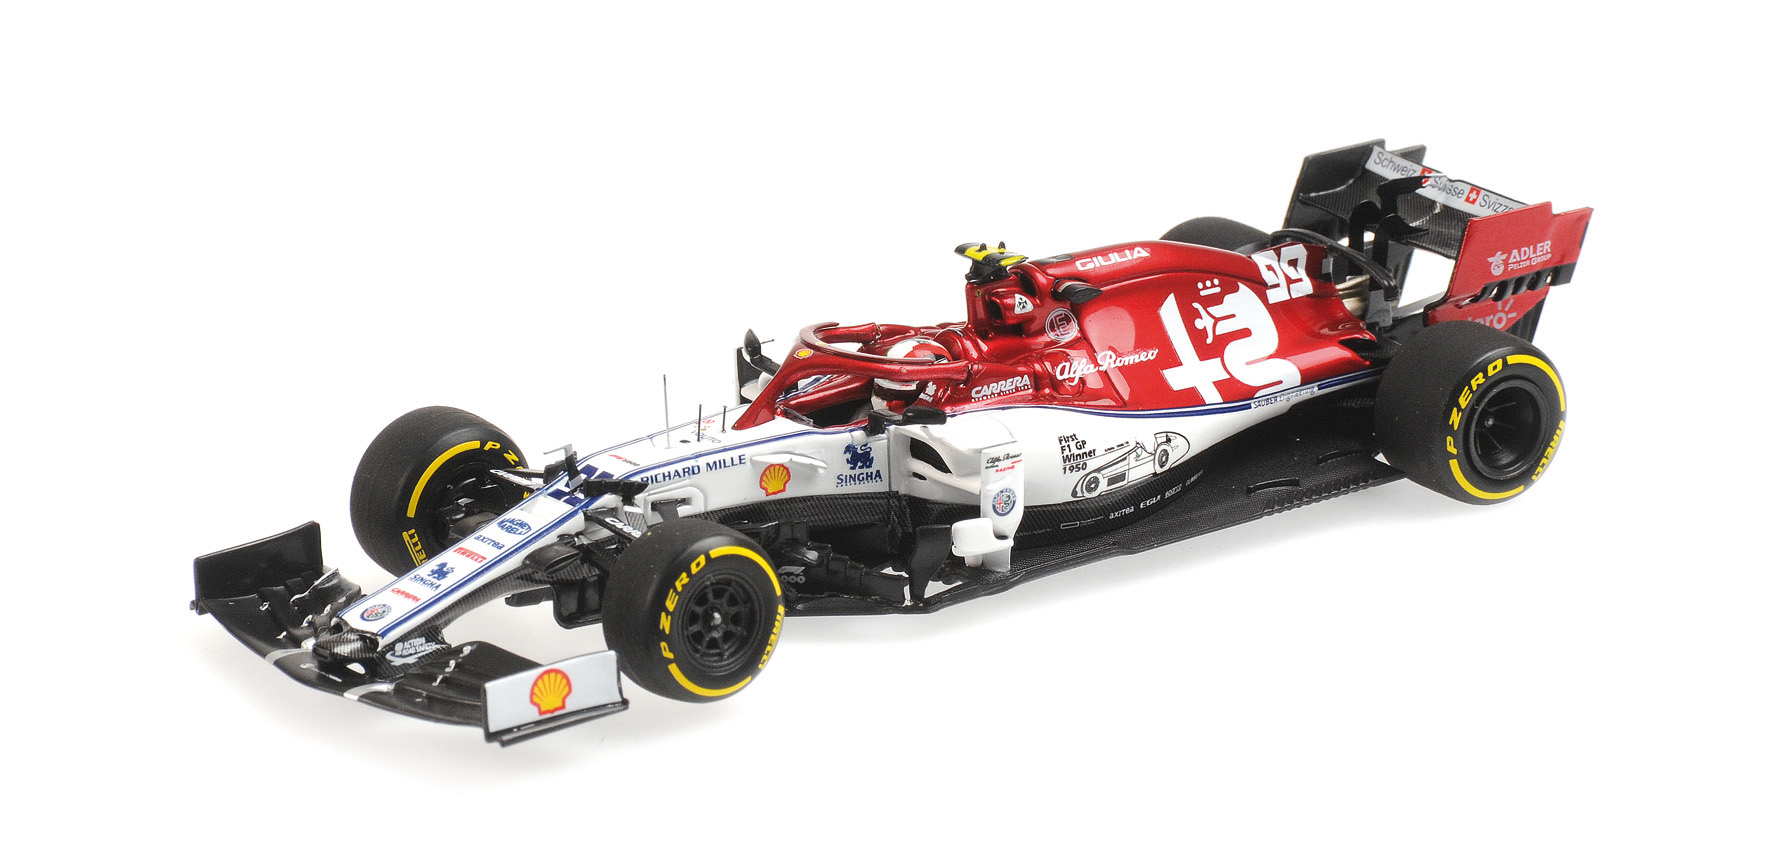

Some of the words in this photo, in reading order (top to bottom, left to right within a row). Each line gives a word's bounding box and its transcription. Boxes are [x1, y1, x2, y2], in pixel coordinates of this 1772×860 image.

[1373, 151, 1416, 177] Schweiz
[1075, 246, 1150, 271] GIULIA
[1508, 240, 1552, 263] ADLER
[1250, 244, 1314, 305] 99
[1055, 359, 1098, 387] Alfa
[1095, 348, 1159, 371] Romeo
[971, 374, 1031, 398] CARRERA
[1449, 358, 1503, 431] ZERO
[1058, 433, 1079, 445] First
[1060, 443, 1072, 455] F1
[1075, 439, 1087, 450] GP
[1446, 435, 1458, 455] P
[1531, 419, 1566, 481] PIRELLI
[1062, 448, 1096, 464] Winner
[640, 464, 701, 486] RICHARD
[705, 454, 747, 472] MILLE
[836, 470, 883, 485] SINGHA
[1062, 462, 1087, 475] 1950
[409, 573, 442, 592] SINGHA
[659, 554, 706, 635] ZERO
[660, 641, 675, 660] P
